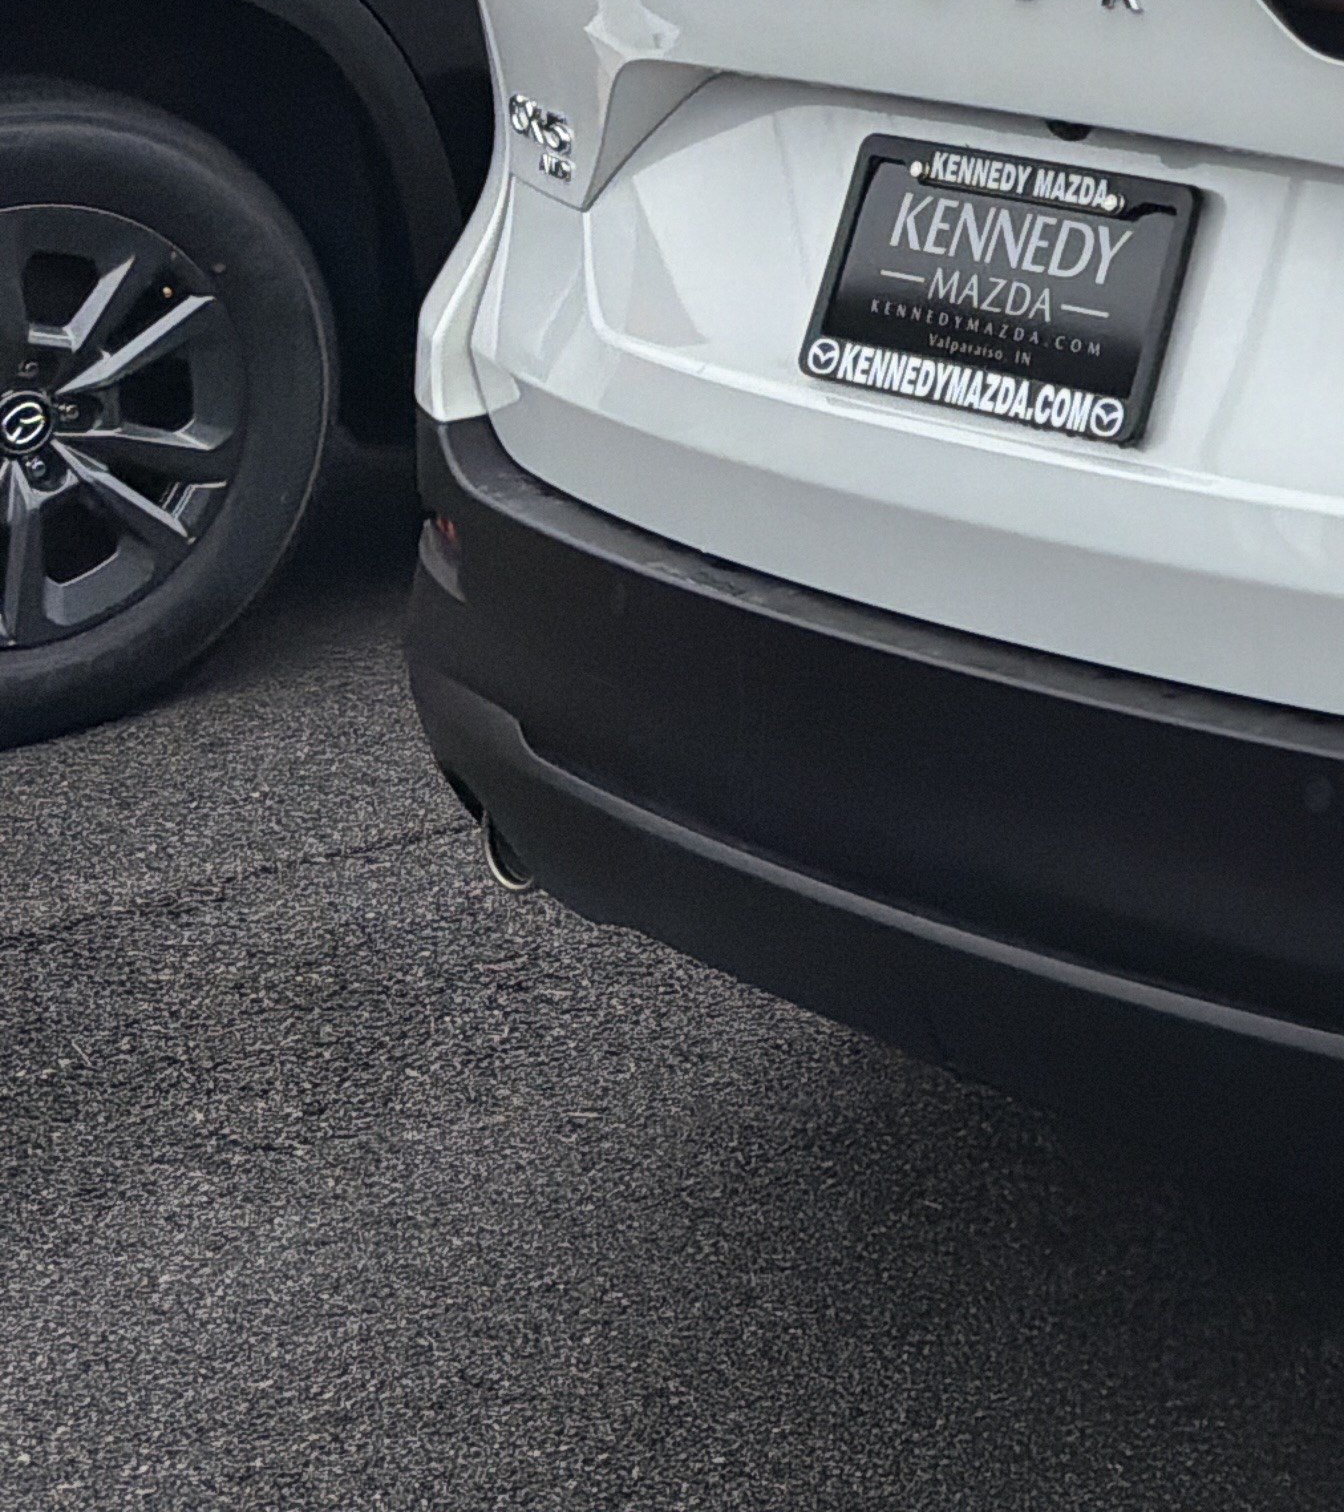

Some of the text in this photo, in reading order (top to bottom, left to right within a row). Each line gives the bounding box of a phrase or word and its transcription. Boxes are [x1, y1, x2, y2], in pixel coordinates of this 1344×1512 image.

[930, 150, 1110, 208] KENNEDY MAZDA
[888, 191, 1134, 286] KENNEDY
[927, 267, 1053, 323] MAZDA
[870, 297, 1102, 358] KENNEDYMAZDA.COM
[836, 342, 1094, 433] KENNEDYMAZDA.COM
[1014, 349, 1033, 367] IN
